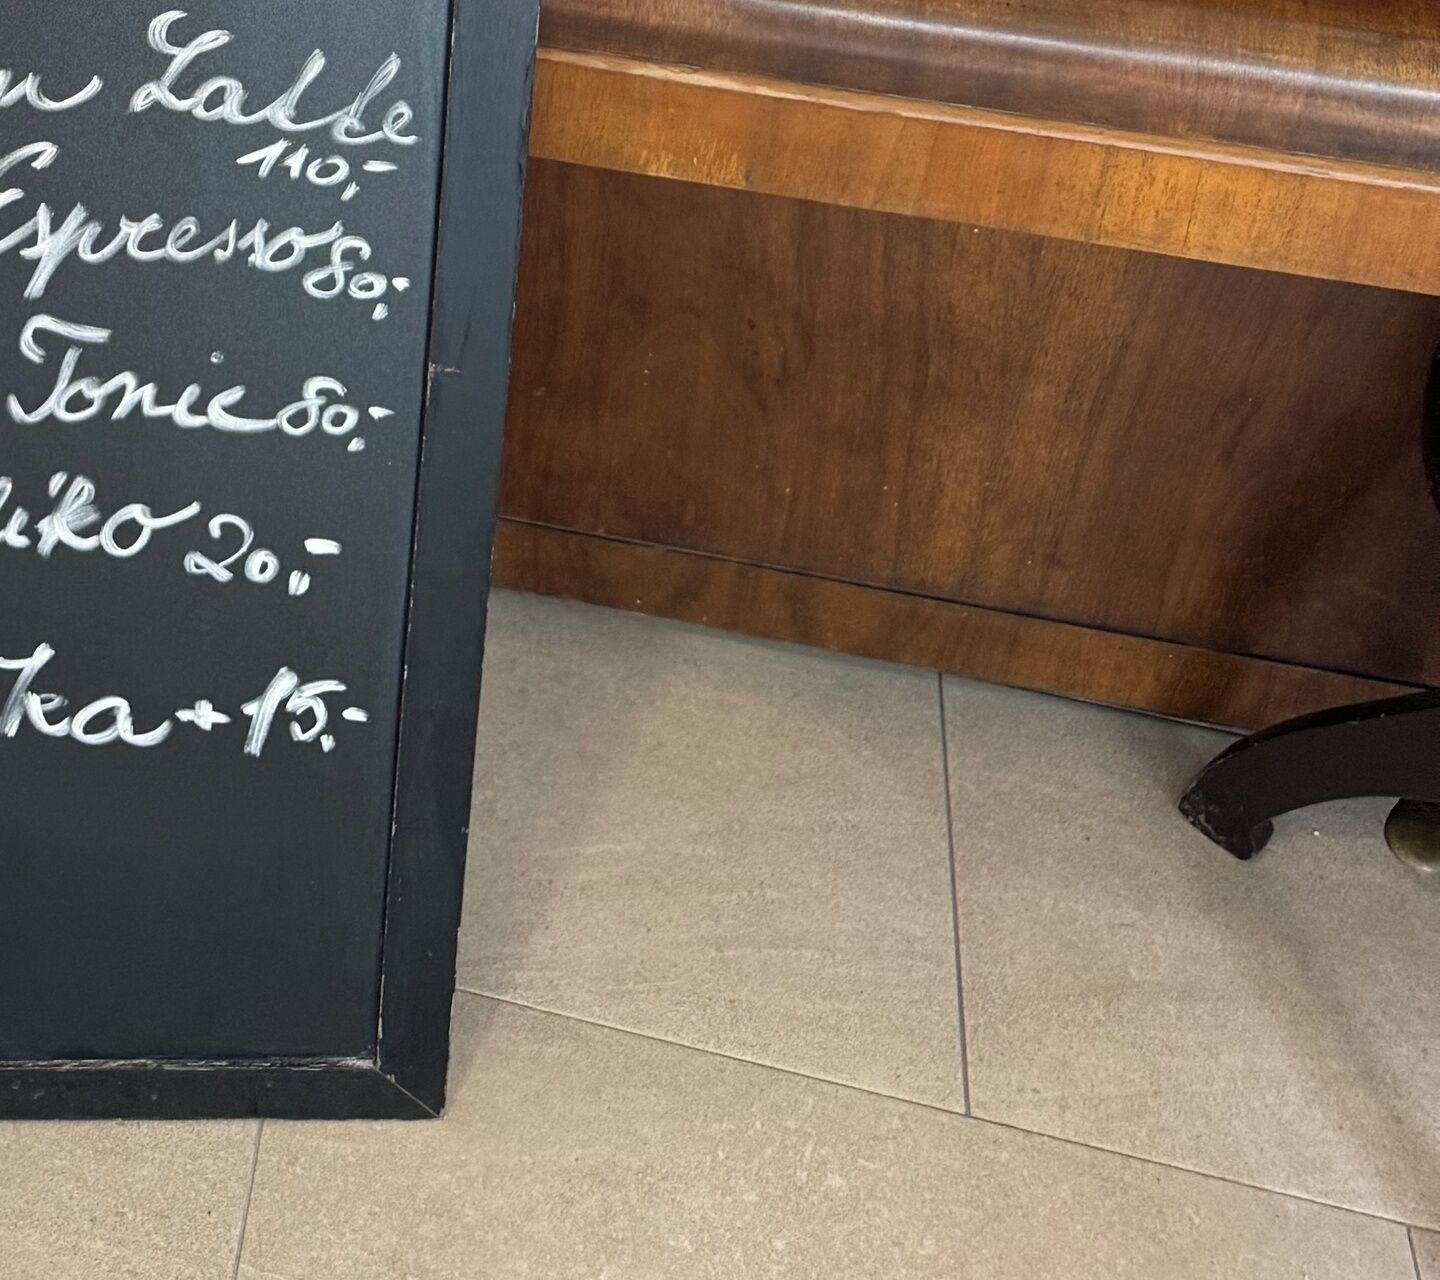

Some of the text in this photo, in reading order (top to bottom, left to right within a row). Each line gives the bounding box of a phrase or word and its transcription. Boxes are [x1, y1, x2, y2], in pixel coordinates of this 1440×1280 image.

[128, 10, 420, 145] Latte
[236, 138, 398, 201] 110,-
[303, 236, 410, 320] 80,-
[7, 314, 277, 432] Tonic
[276, 376, 393, 452] 80,-
[184, 513, 341, 595] 20,-
